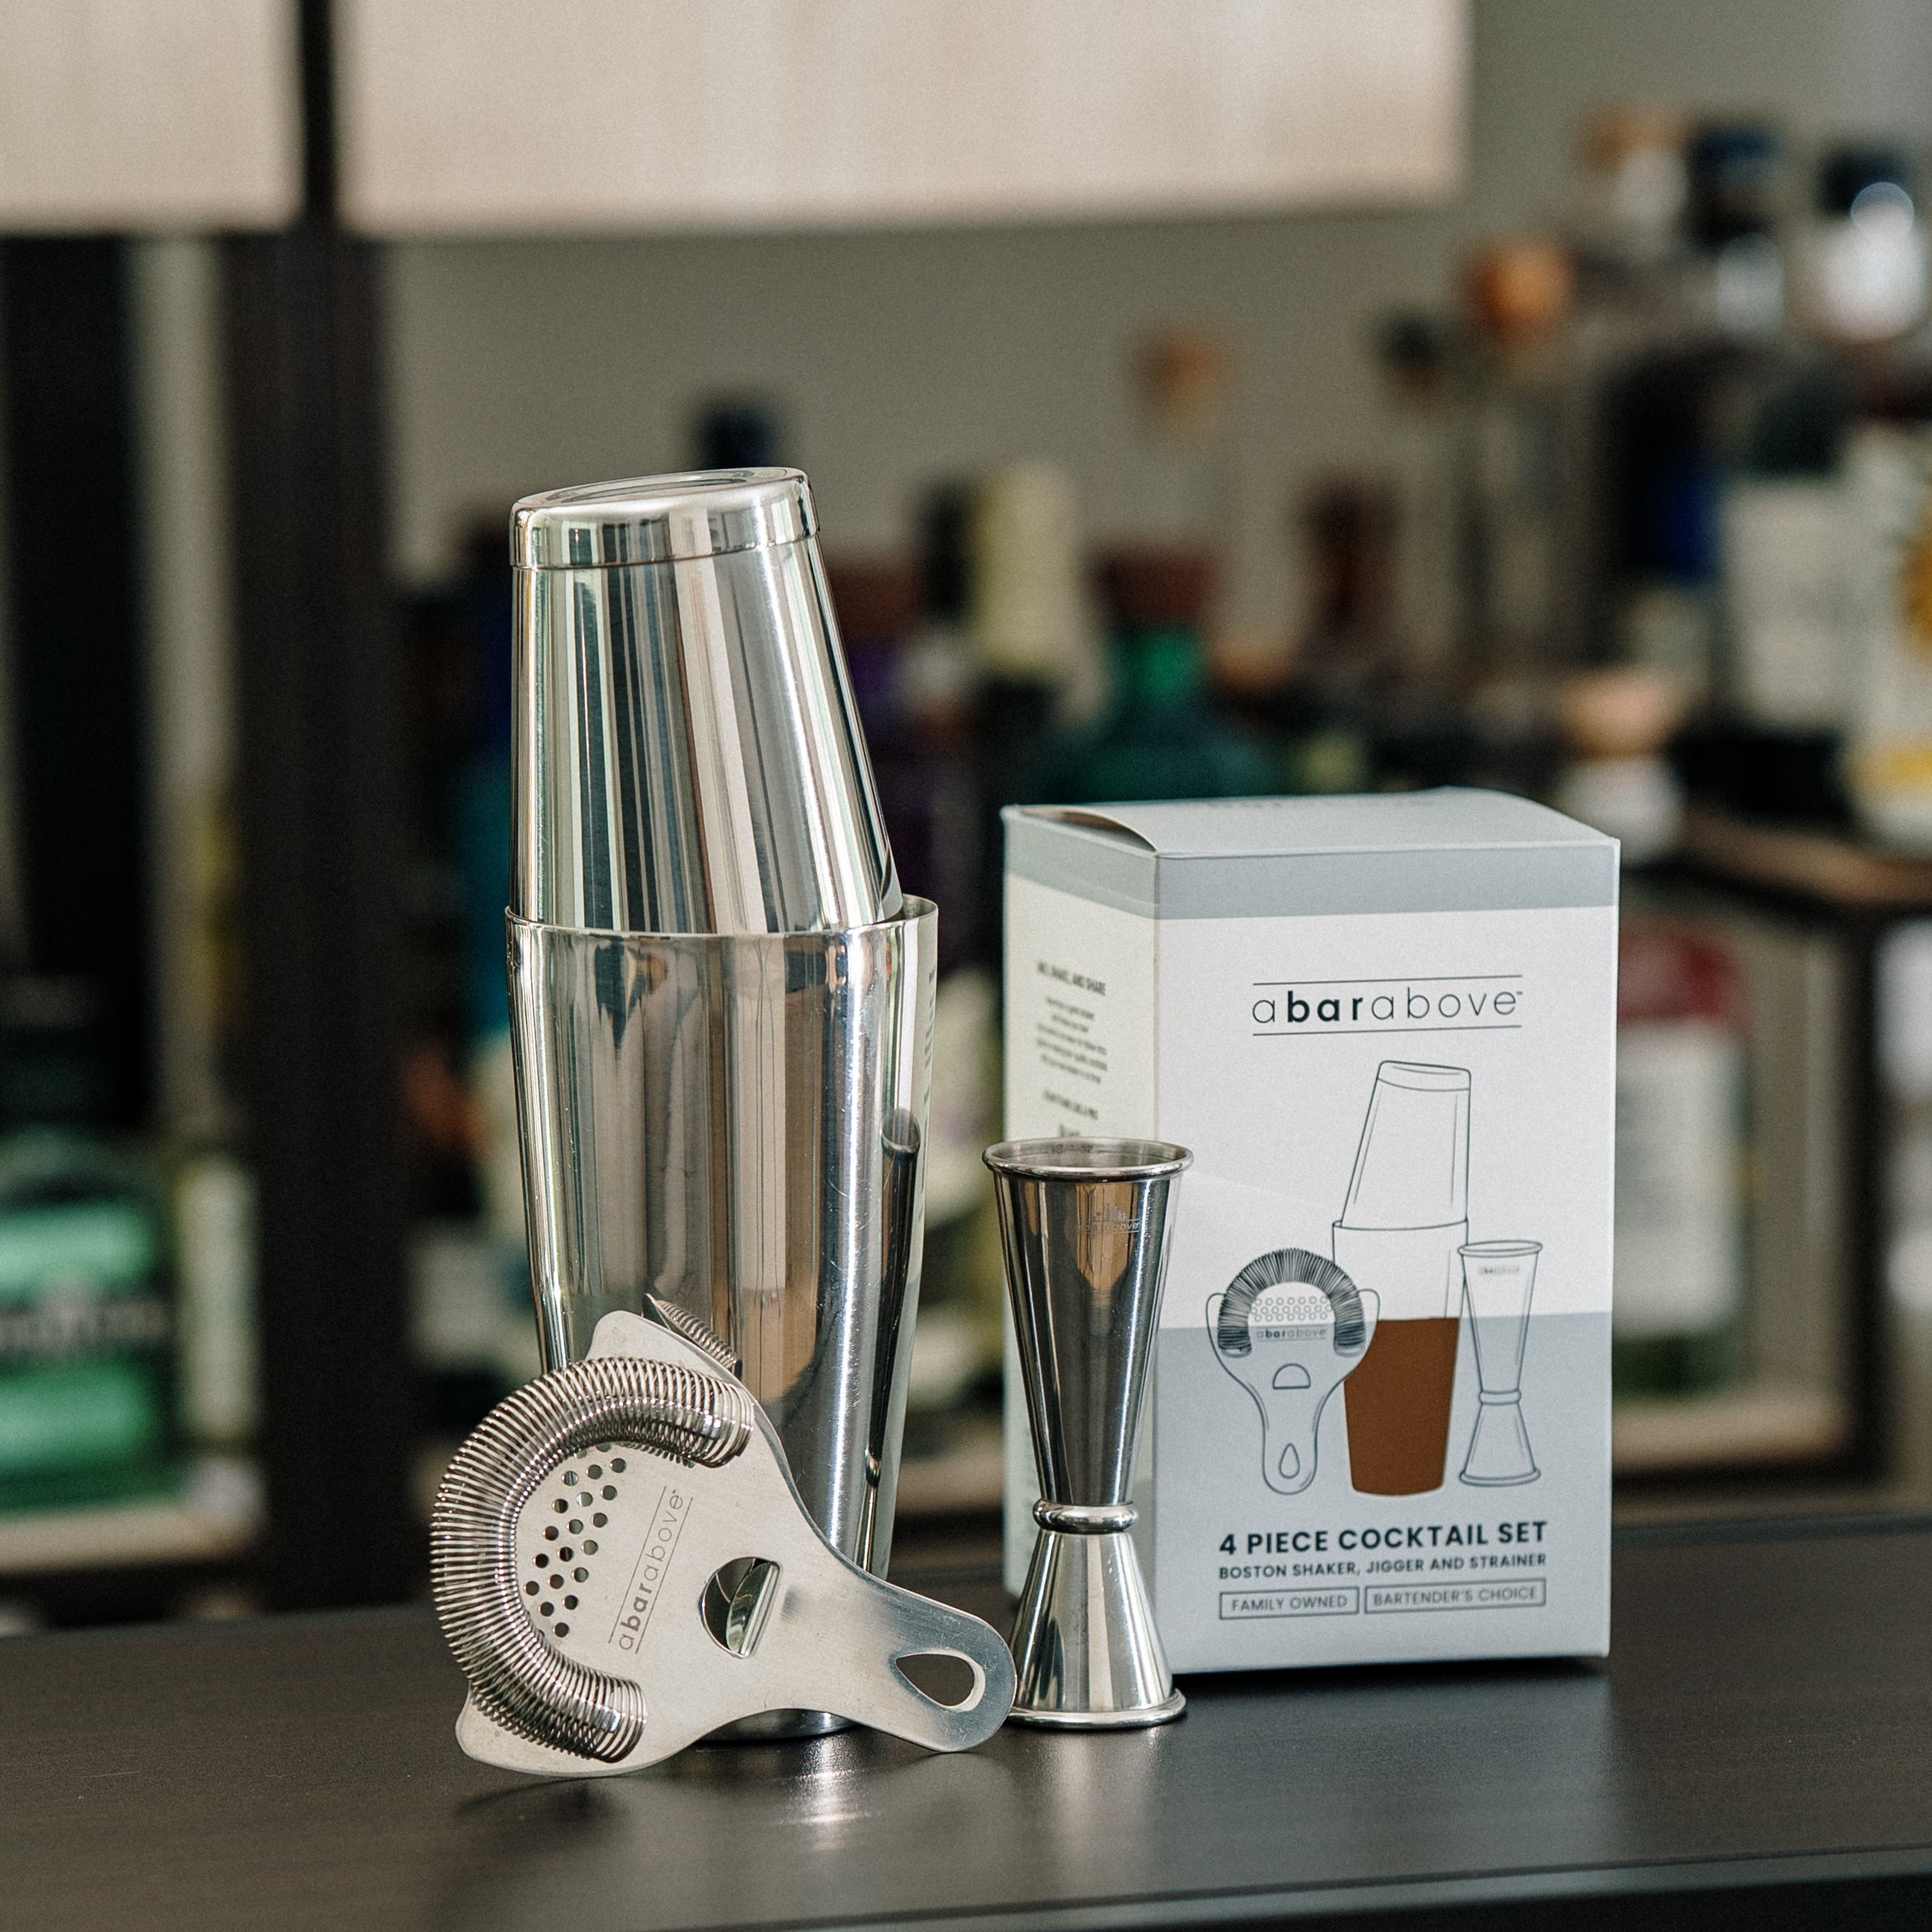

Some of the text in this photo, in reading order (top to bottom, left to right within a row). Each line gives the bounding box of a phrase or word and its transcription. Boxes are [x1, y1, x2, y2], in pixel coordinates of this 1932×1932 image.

[1219, 1521, 1548, 1555] 4 PIECE COCKTAIL SET
[1219, 1553, 1547, 1579] BOSTON SHAKER, JIGGER AND STRAINER
[1231, 1594, 1349, 1612] FAMILY OWNED
[1373, 1585, 1537, 1607] BARTENDER'S CHOICE
